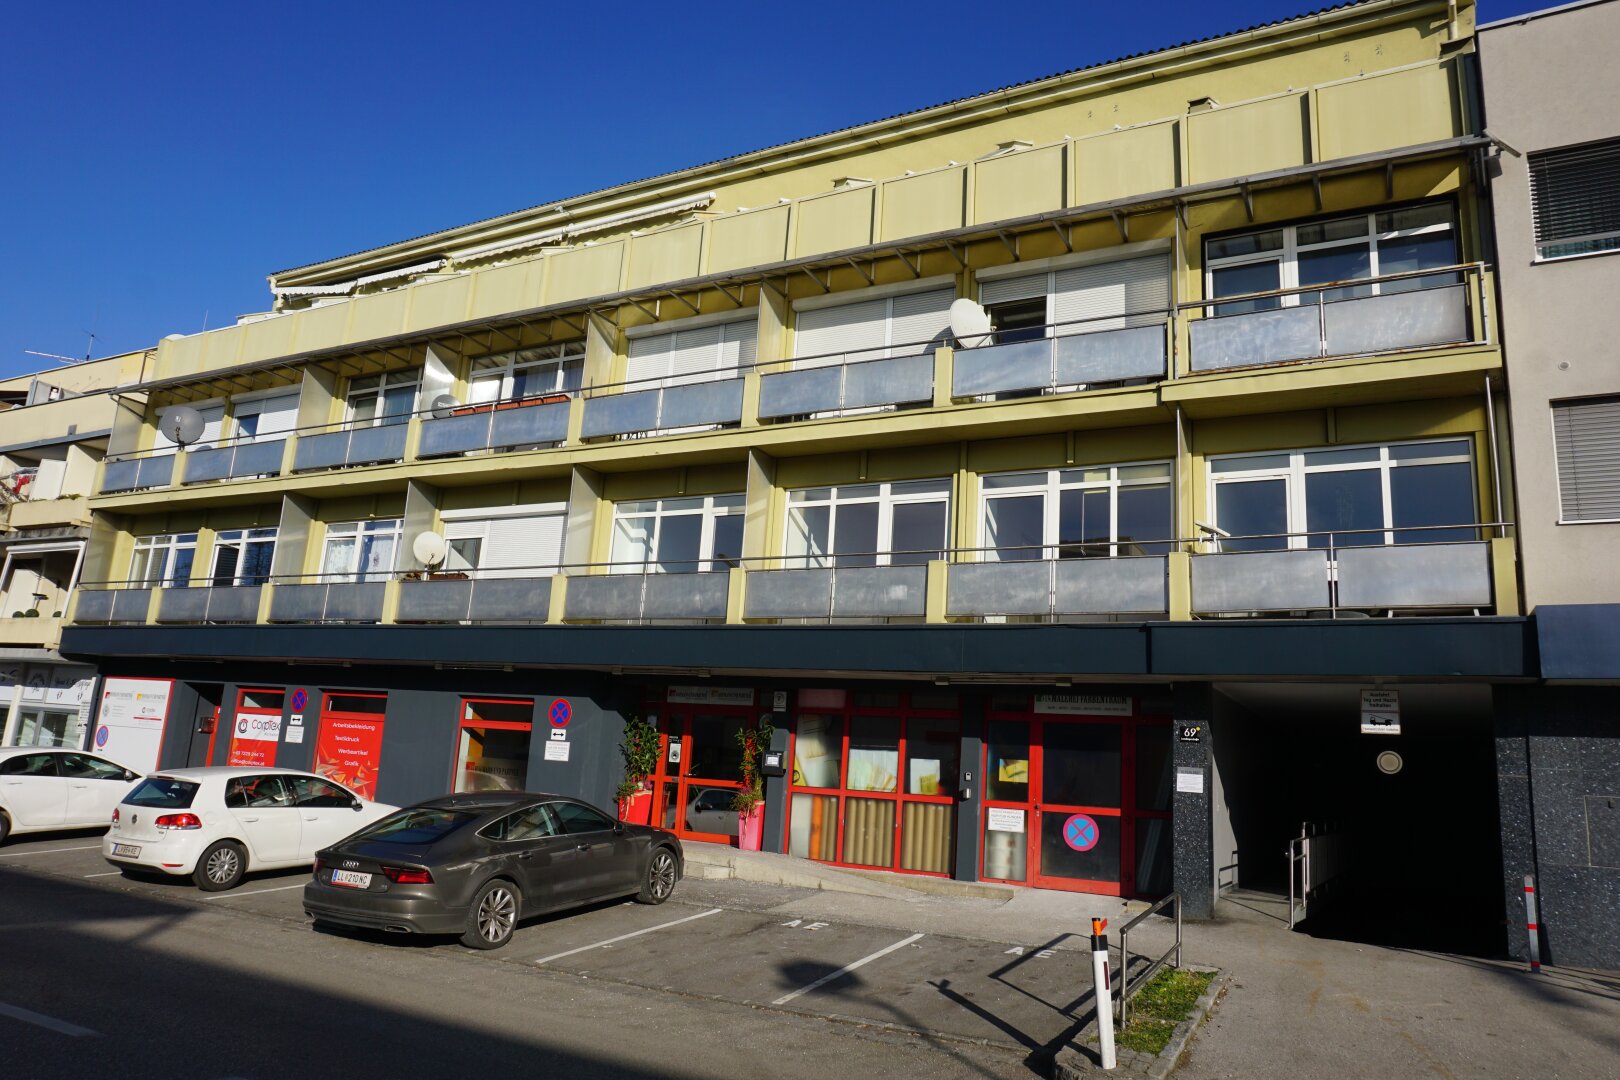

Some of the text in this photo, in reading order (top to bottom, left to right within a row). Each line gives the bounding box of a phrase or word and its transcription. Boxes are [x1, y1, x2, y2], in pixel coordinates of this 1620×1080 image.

[333, 722, 376, 731] Arbeitsbekleidung
[1184, 728, 1197, 737] 69
[335, 735, 360, 743] Textildruck
[338, 748, 369, 756] Werbeartikel
